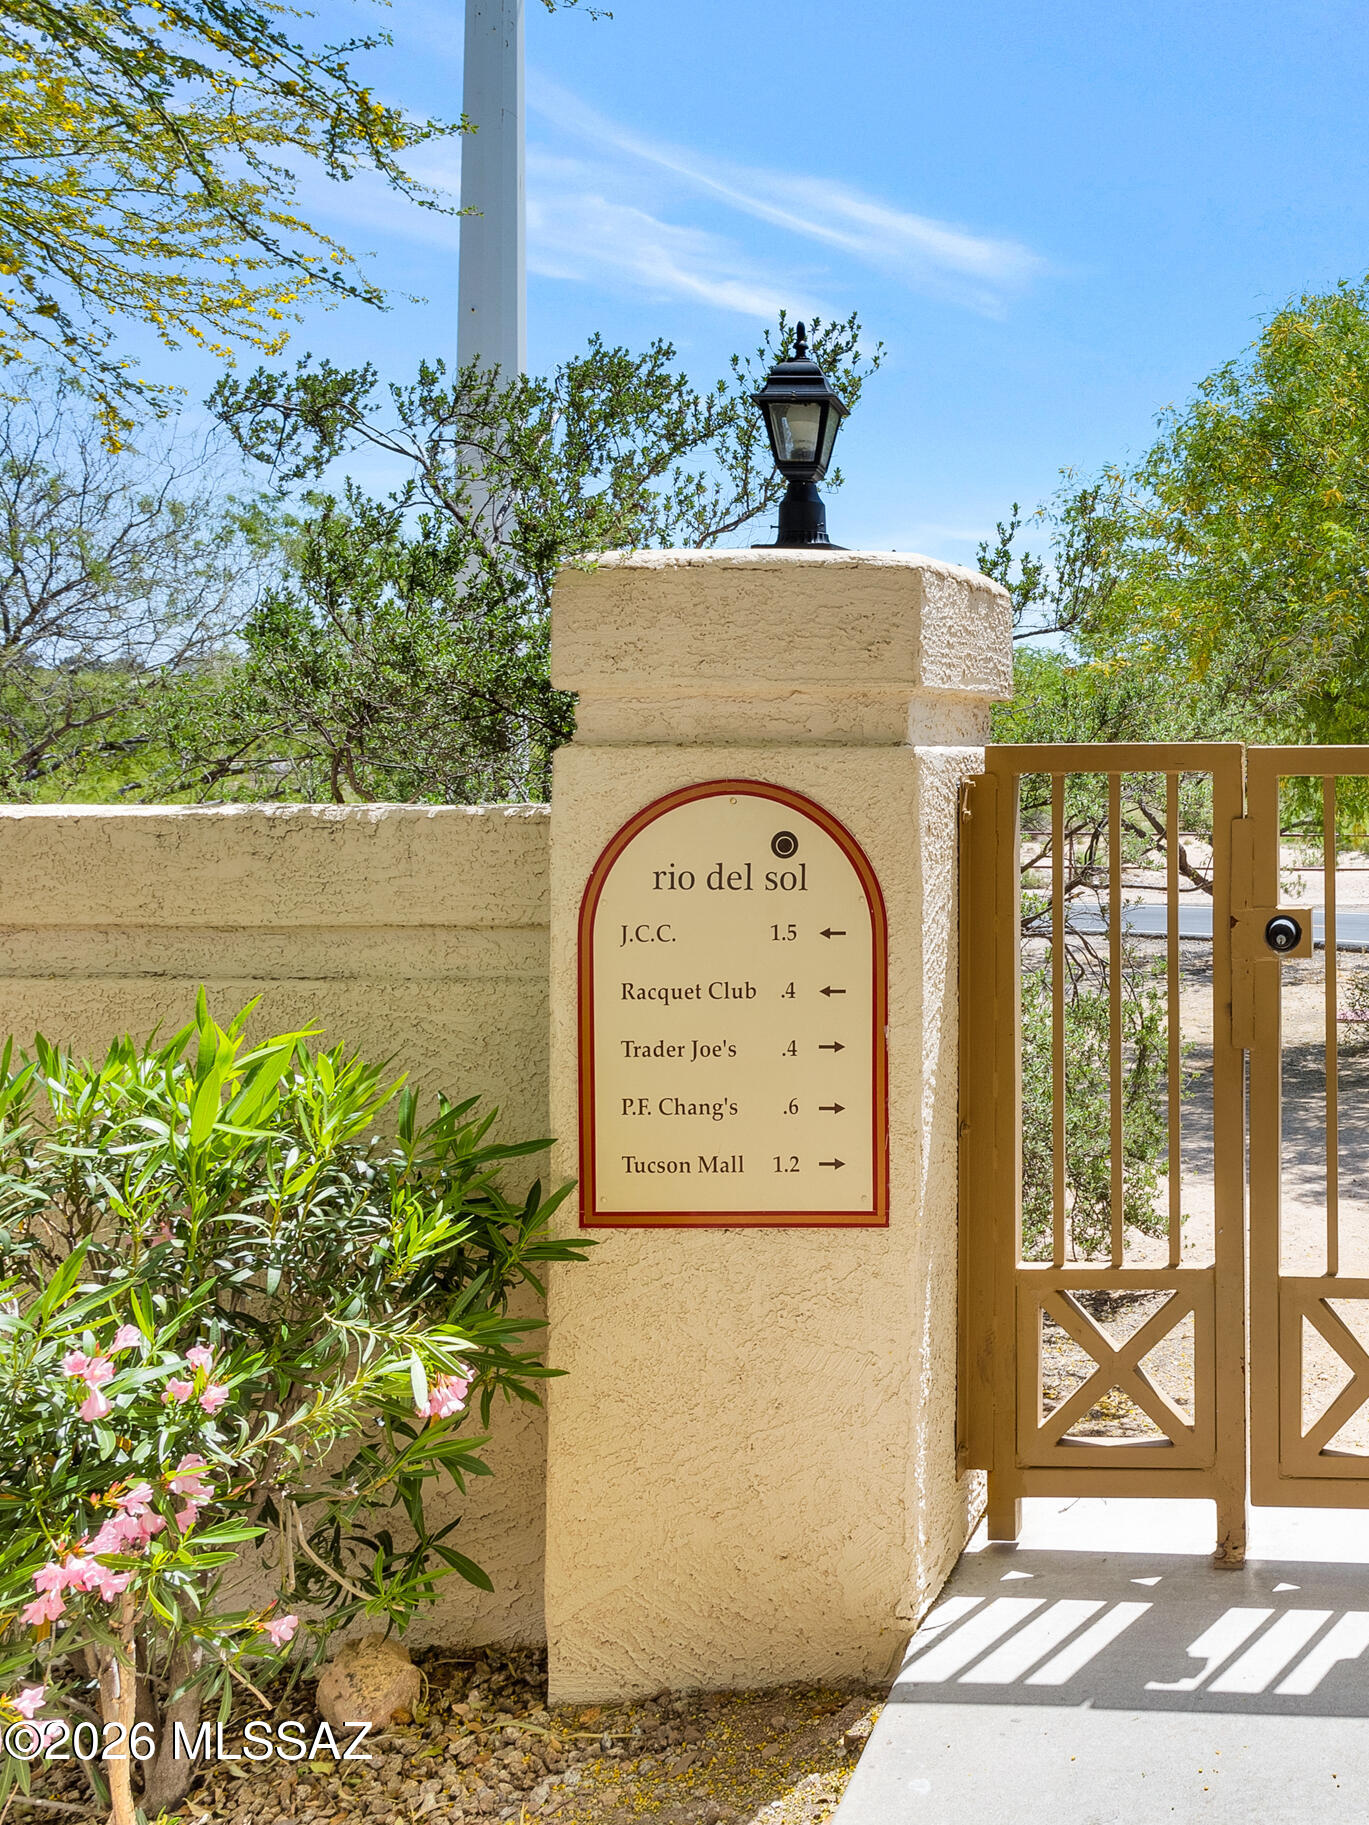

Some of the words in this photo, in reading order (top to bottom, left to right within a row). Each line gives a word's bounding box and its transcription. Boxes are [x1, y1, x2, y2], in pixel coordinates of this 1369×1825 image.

[652, 863, 695, 890] rio
[706, 863, 754, 891] del
[765, 863, 809, 891] sol
[620, 924, 676, 947] J.C.C.
[770, 923, 798, 941] 1.5
[621, 982, 702, 1005] Racquet
[708, 981, 757, 999] Club
[780, 981, 796, 999] .4
[621, 1040, 686, 1058] Trader
[690, 1040, 737, 1062] Joe's
[782, 1040, 798, 1057] .4
[621, 1098, 652, 1115] P.F.
[658, 1098, 738, 1121] Chang's
[783, 1098, 799, 1115] .6
[621, 1156, 691, 1174] Tucson
[698, 1155, 745, 1173] Mall
[773, 1156, 800, 1173] 1.2
